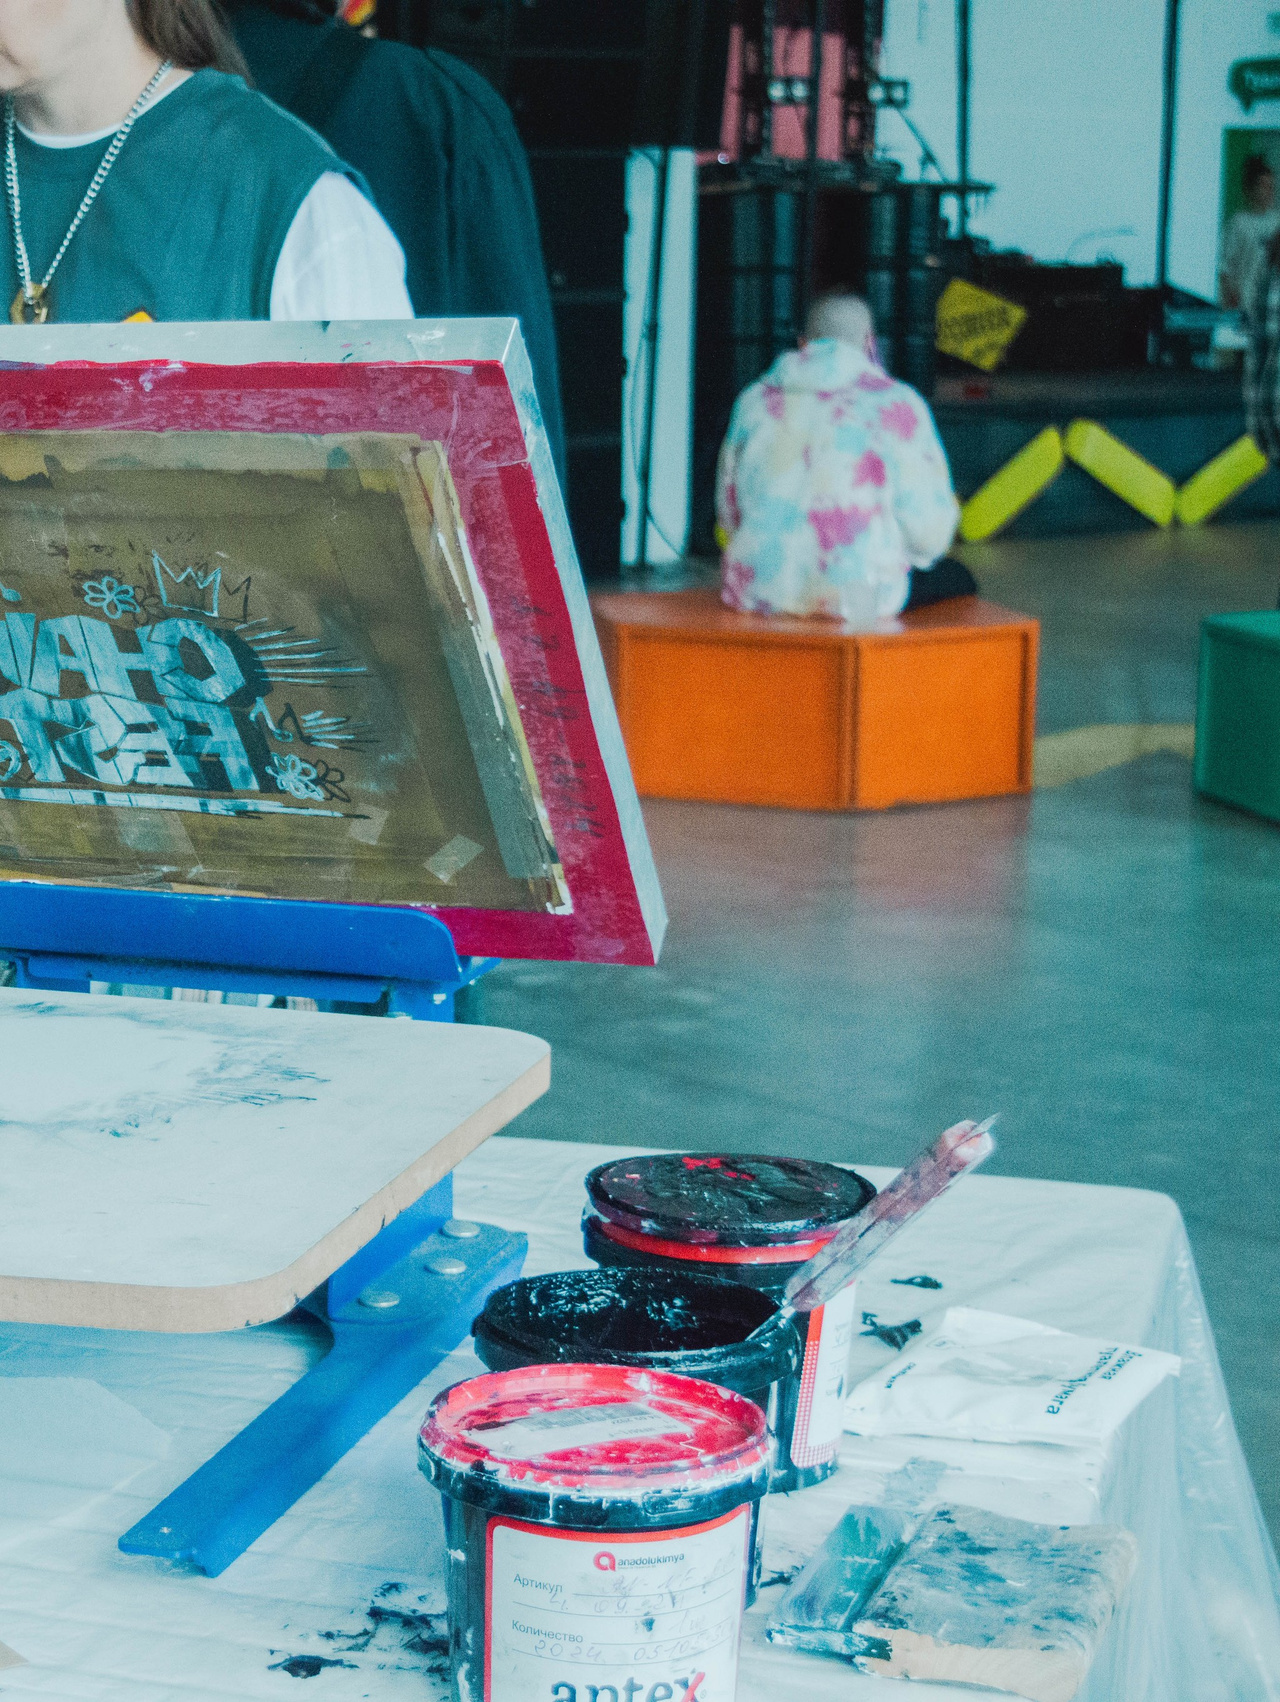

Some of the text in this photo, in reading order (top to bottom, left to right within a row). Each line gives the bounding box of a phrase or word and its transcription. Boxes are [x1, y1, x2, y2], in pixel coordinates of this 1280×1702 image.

[617, 1553, 686, 1568] anadolukimya
[513, 1573, 563, 1594] Артикул
[511, 1620, 584, 1644] Количество
